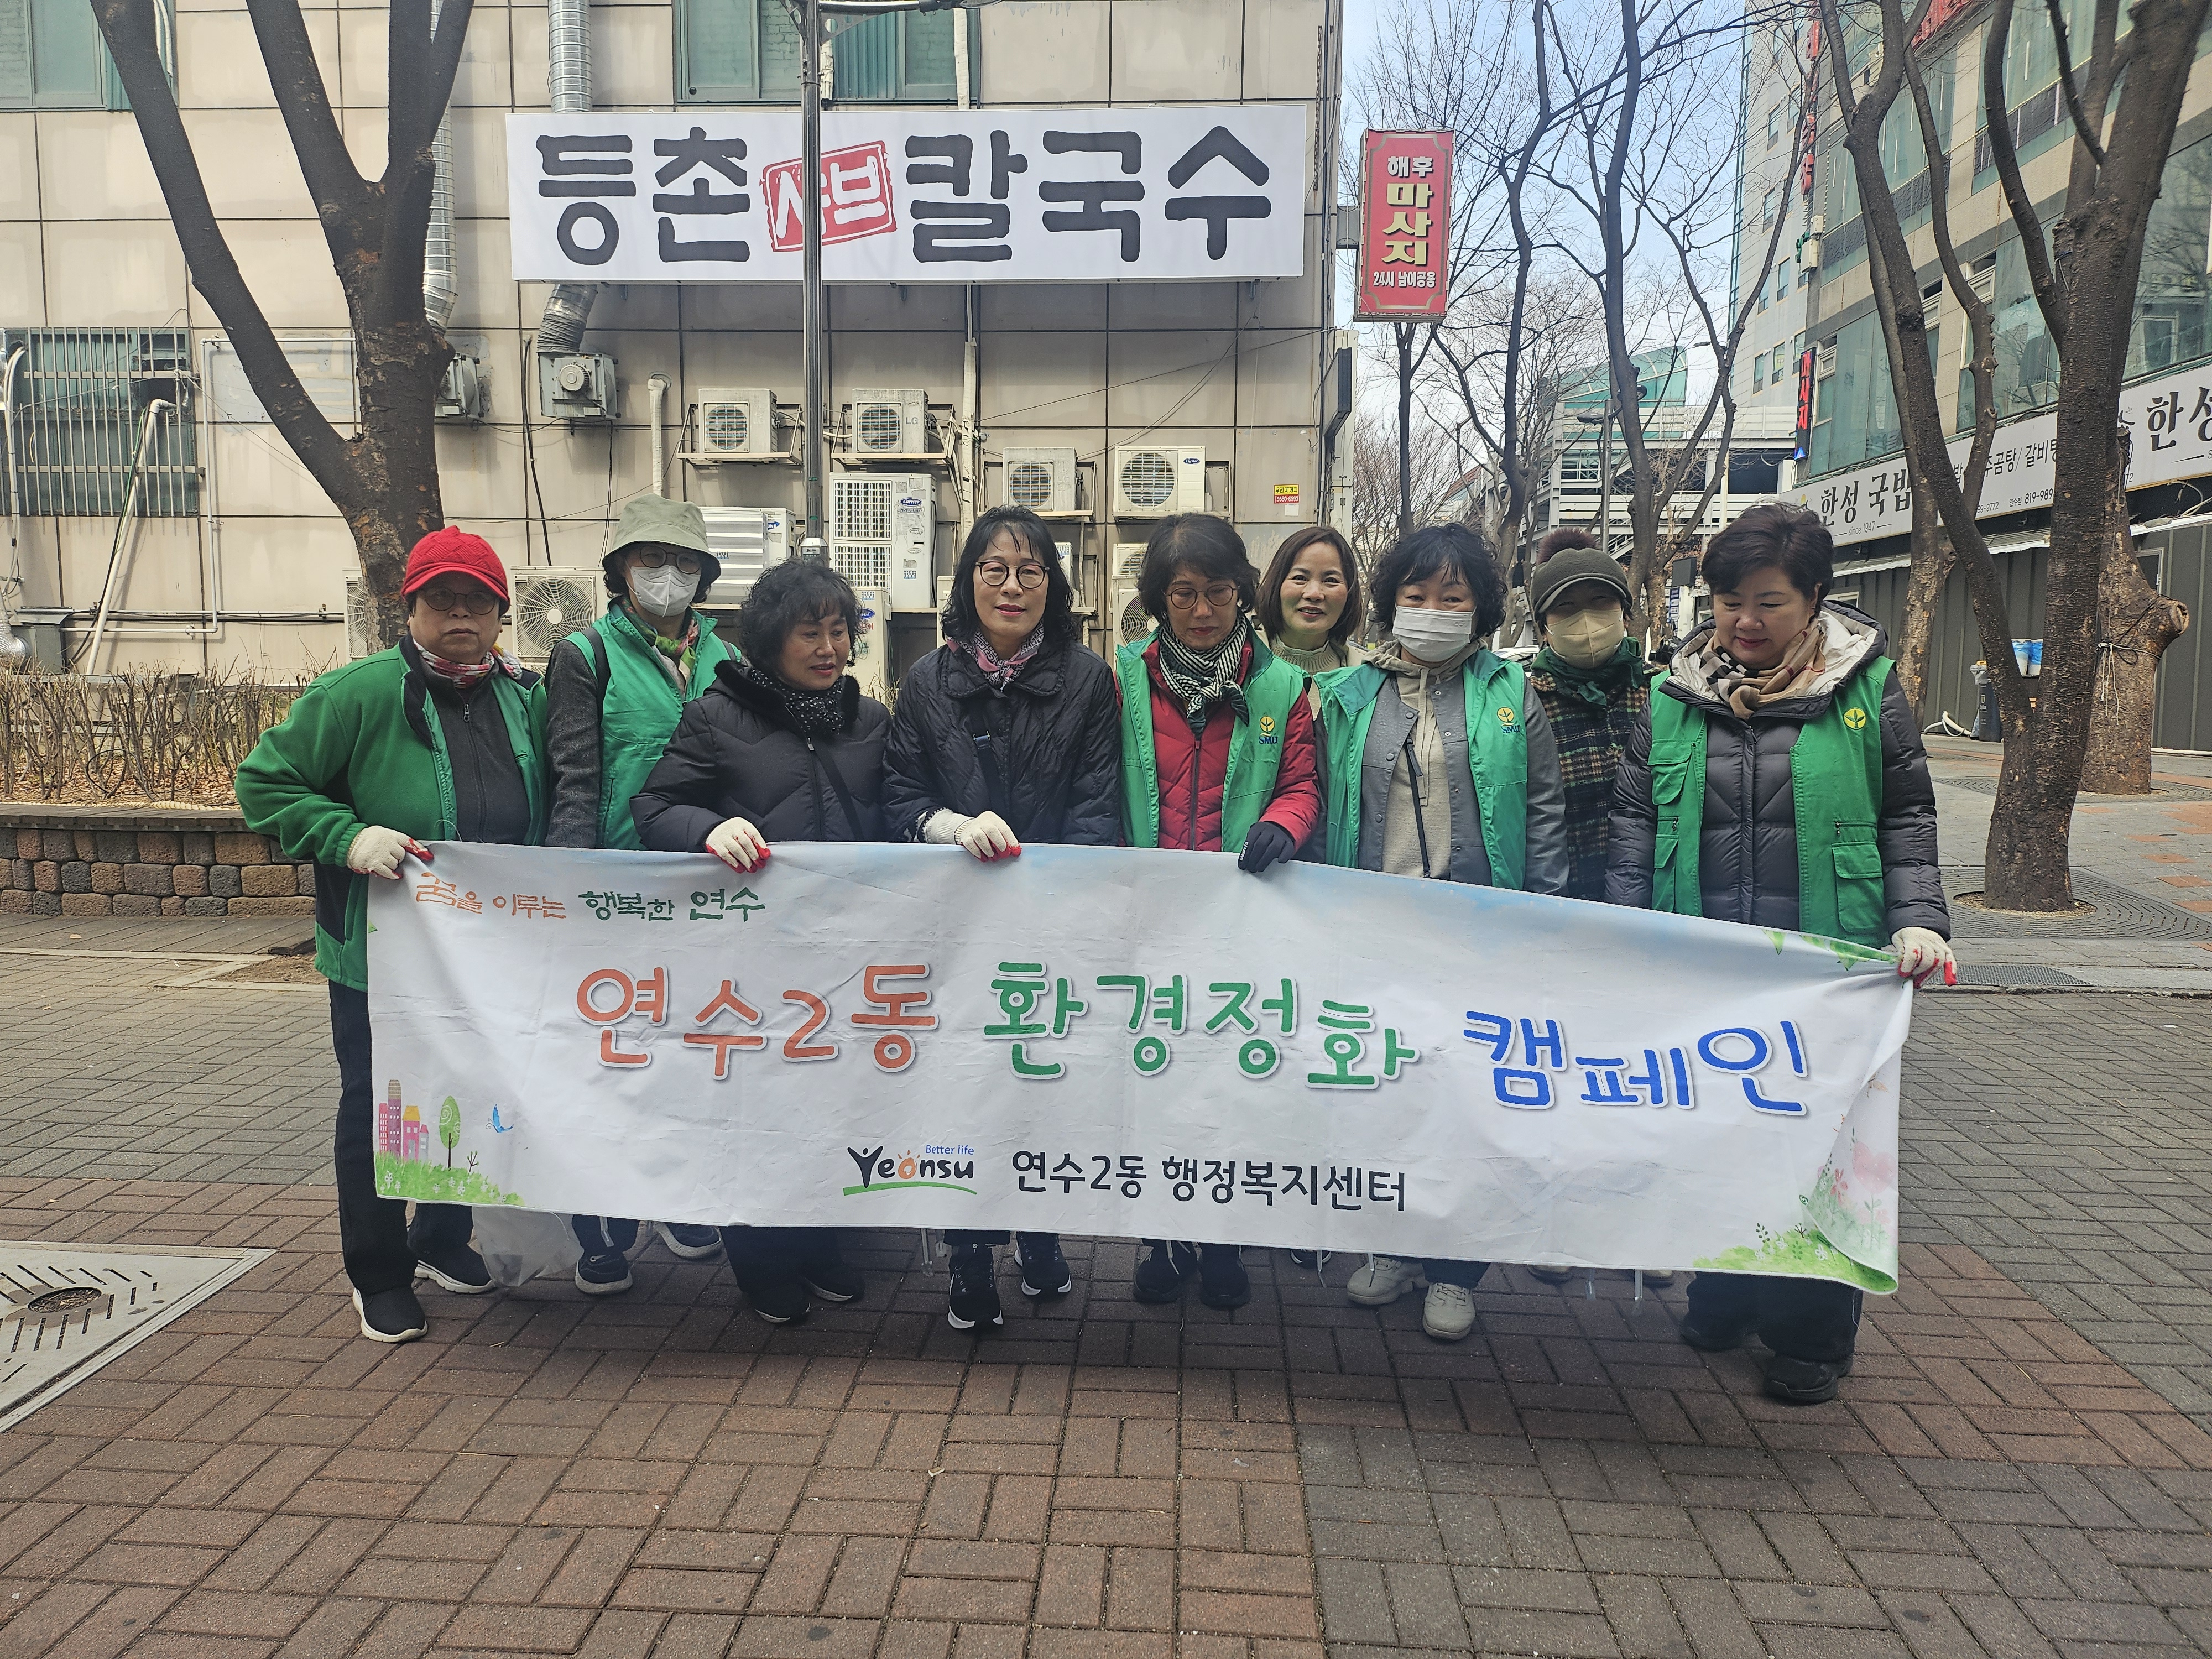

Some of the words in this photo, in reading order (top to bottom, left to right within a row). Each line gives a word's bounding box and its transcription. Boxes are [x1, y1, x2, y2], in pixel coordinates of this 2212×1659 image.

[1387, 156, 1433, 178] 해후
[535, 126, 750, 265] 등촌
[905, 126, 1271, 263] 칼국수
[1381, 183, 1433, 265] 마사지
[1373, 271, 1395, 287] 24시
[1398, 271, 1436, 288] 남여공용
[906, 416, 919, 425] LG
[1820, 481, 1859, 526] 한성
[1868, 469, 1911, 518] 국밥
[1848, 526, 1861, 536] since
[1863, 520, 1876, 534] 1947
[1500, 723, 1520, 734] SMU
[1259, 735, 1279, 745] SMU
[416, 872, 483, 914] 꿈을
[493, 893, 567, 919] 이루는
[578, 890, 675, 921] 행복한
[690, 886, 766, 922] 연수
[576, 964, 937, 1077] 연수2동
[983, 961, 1417, 1086] 환경정화
[1463, 1010, 1806, 1112] 캠페인
[925, 1144, 955, 1156] Better
[957, 1144, 974, 1156] life
[847, 1145, 974, 1188] Yeonsu
[1012, 1150, 1147, 1199] 연수2동
[1161, 1155, 1405, 1212] 행정복지센터
